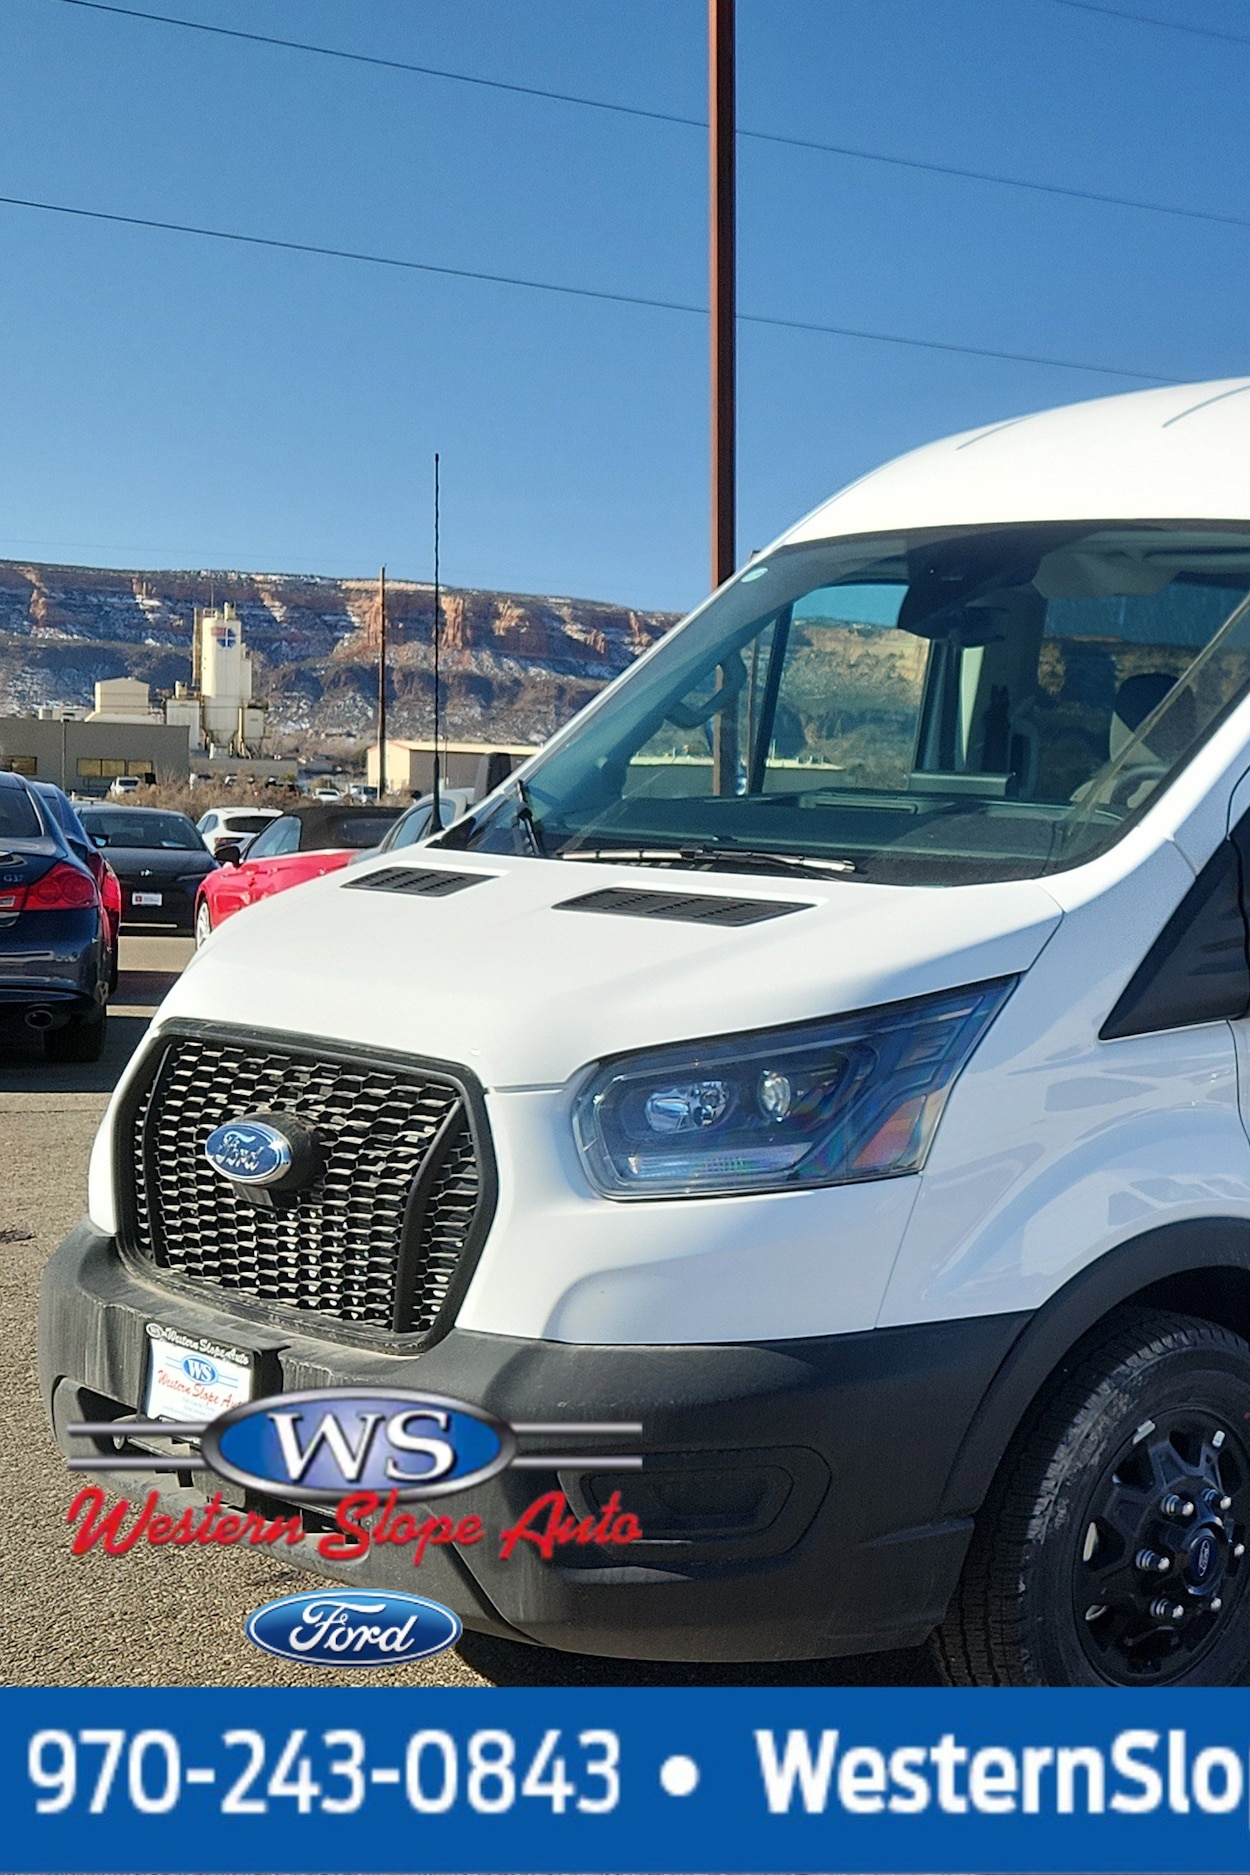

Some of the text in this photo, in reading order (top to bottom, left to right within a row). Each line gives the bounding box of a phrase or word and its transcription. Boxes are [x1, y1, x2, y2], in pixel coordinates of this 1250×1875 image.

[214, 1131, 264, 1171] Ford
[165, 1327, 249, 1365] Western Slope Auto
[158, 1370, 191, 1395] Western
[191, 1382, 218, 1407] Slope
[186, 1359, 213, 1382] WS
